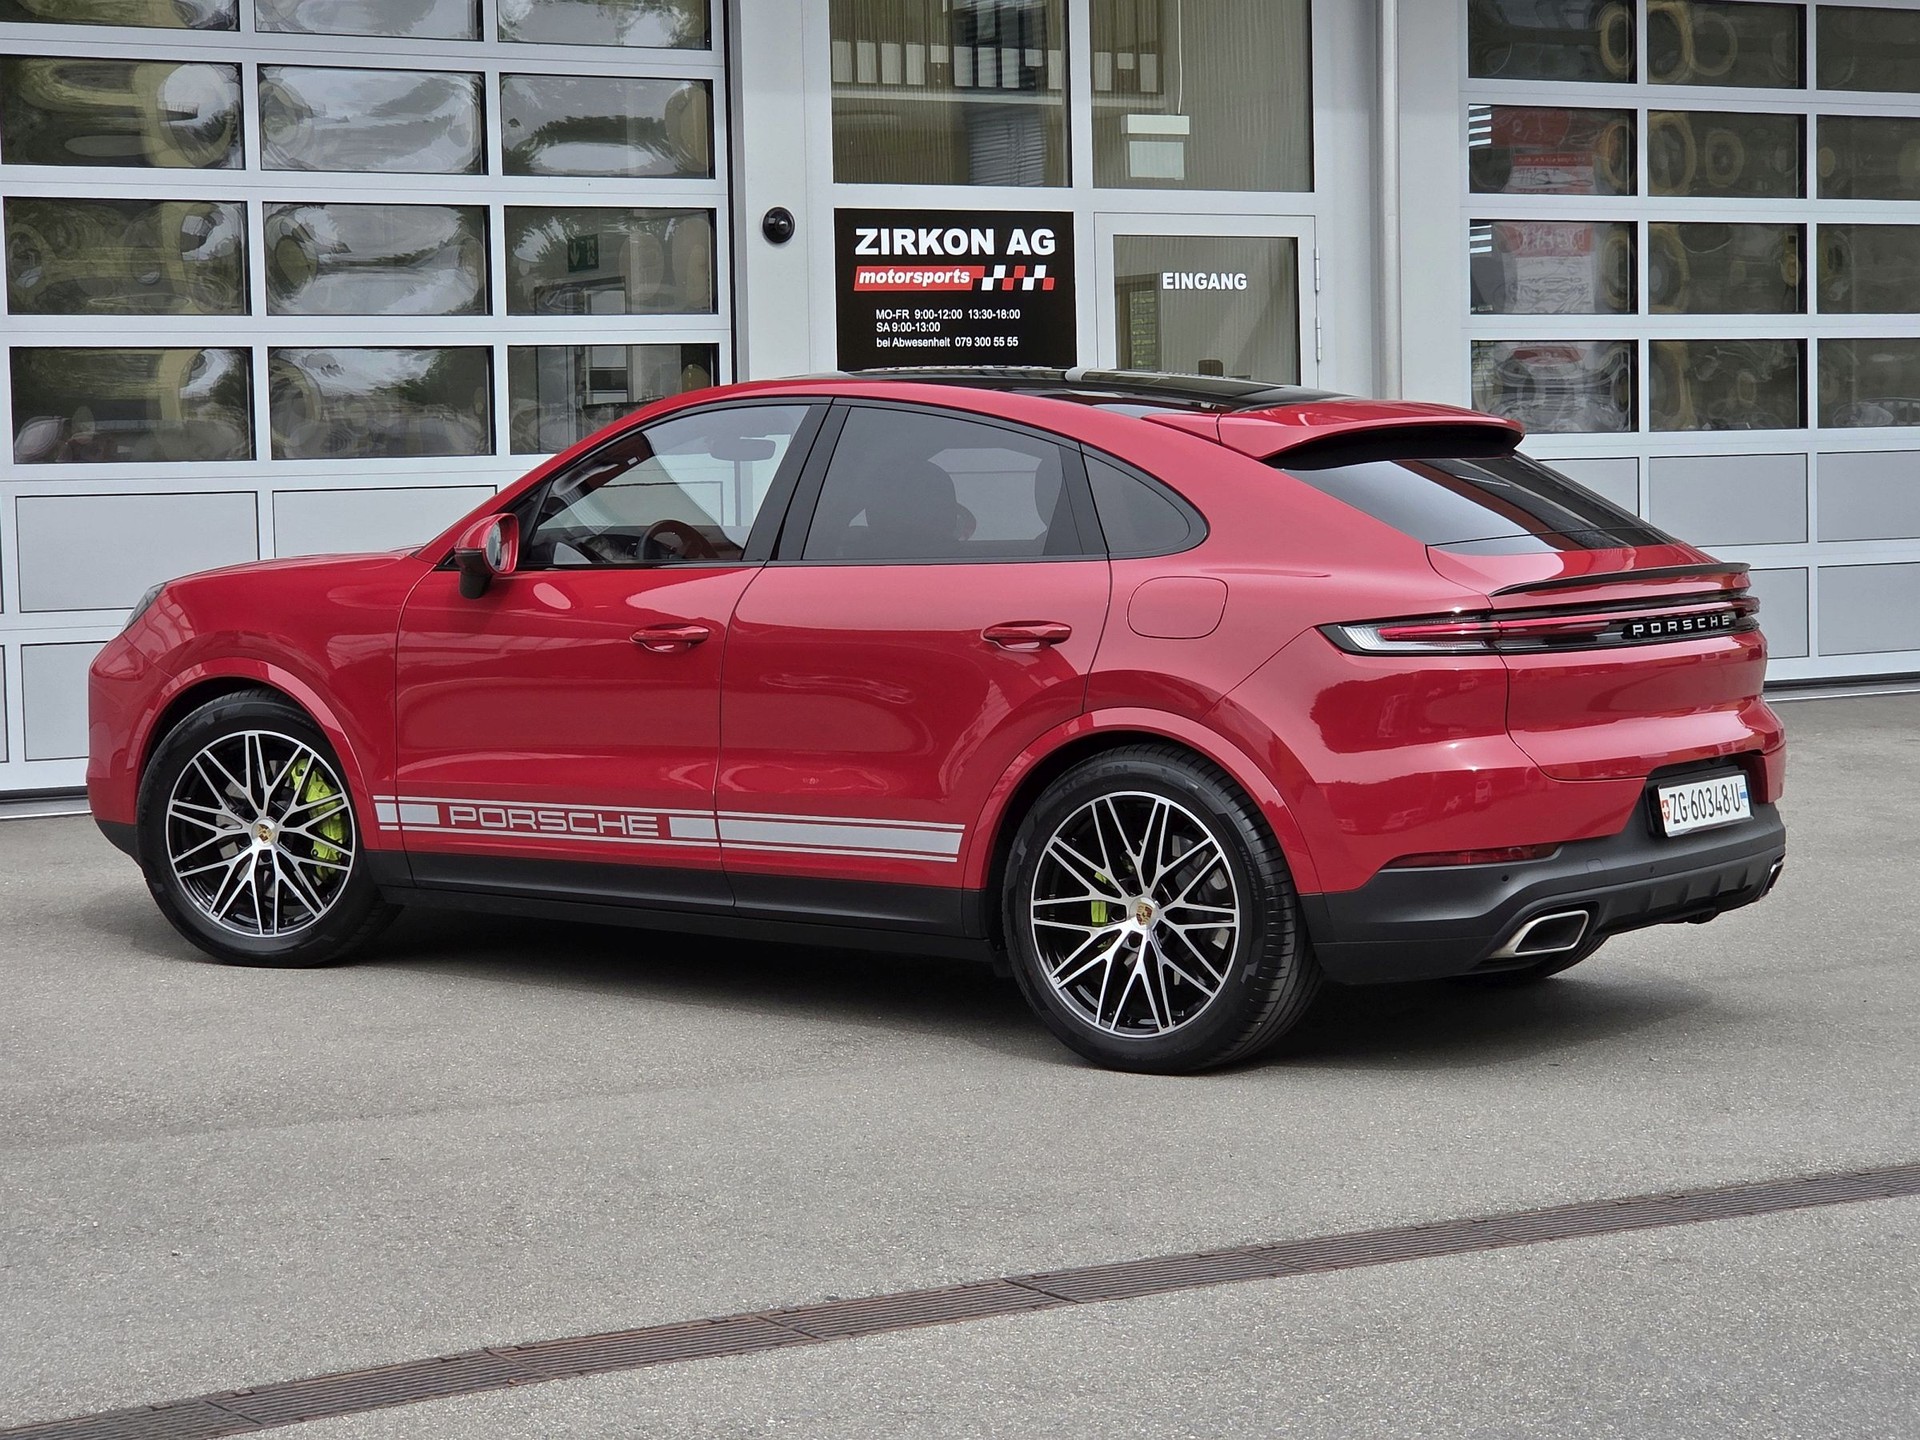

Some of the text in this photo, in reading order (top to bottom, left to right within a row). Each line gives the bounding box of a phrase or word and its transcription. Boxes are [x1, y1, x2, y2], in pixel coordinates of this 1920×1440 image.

[854, 228, 1056, 256] ZIRKON AG
[858, 267, 971, 287] motorsports
[1162, 272, 1247, 290] EINGANG
[875, 309, 1021, 320] MO-FR 9:00-12:00 13:30-18:00
[876, 322, 941, 332] SA 9:00-13:00
[876, 336, 1019, 348] bei Abwesenheit 079 300 55 55
[1632, 615, 1730, 636] PORSCHE
[449, 805, 659, 837] PORSCHE
